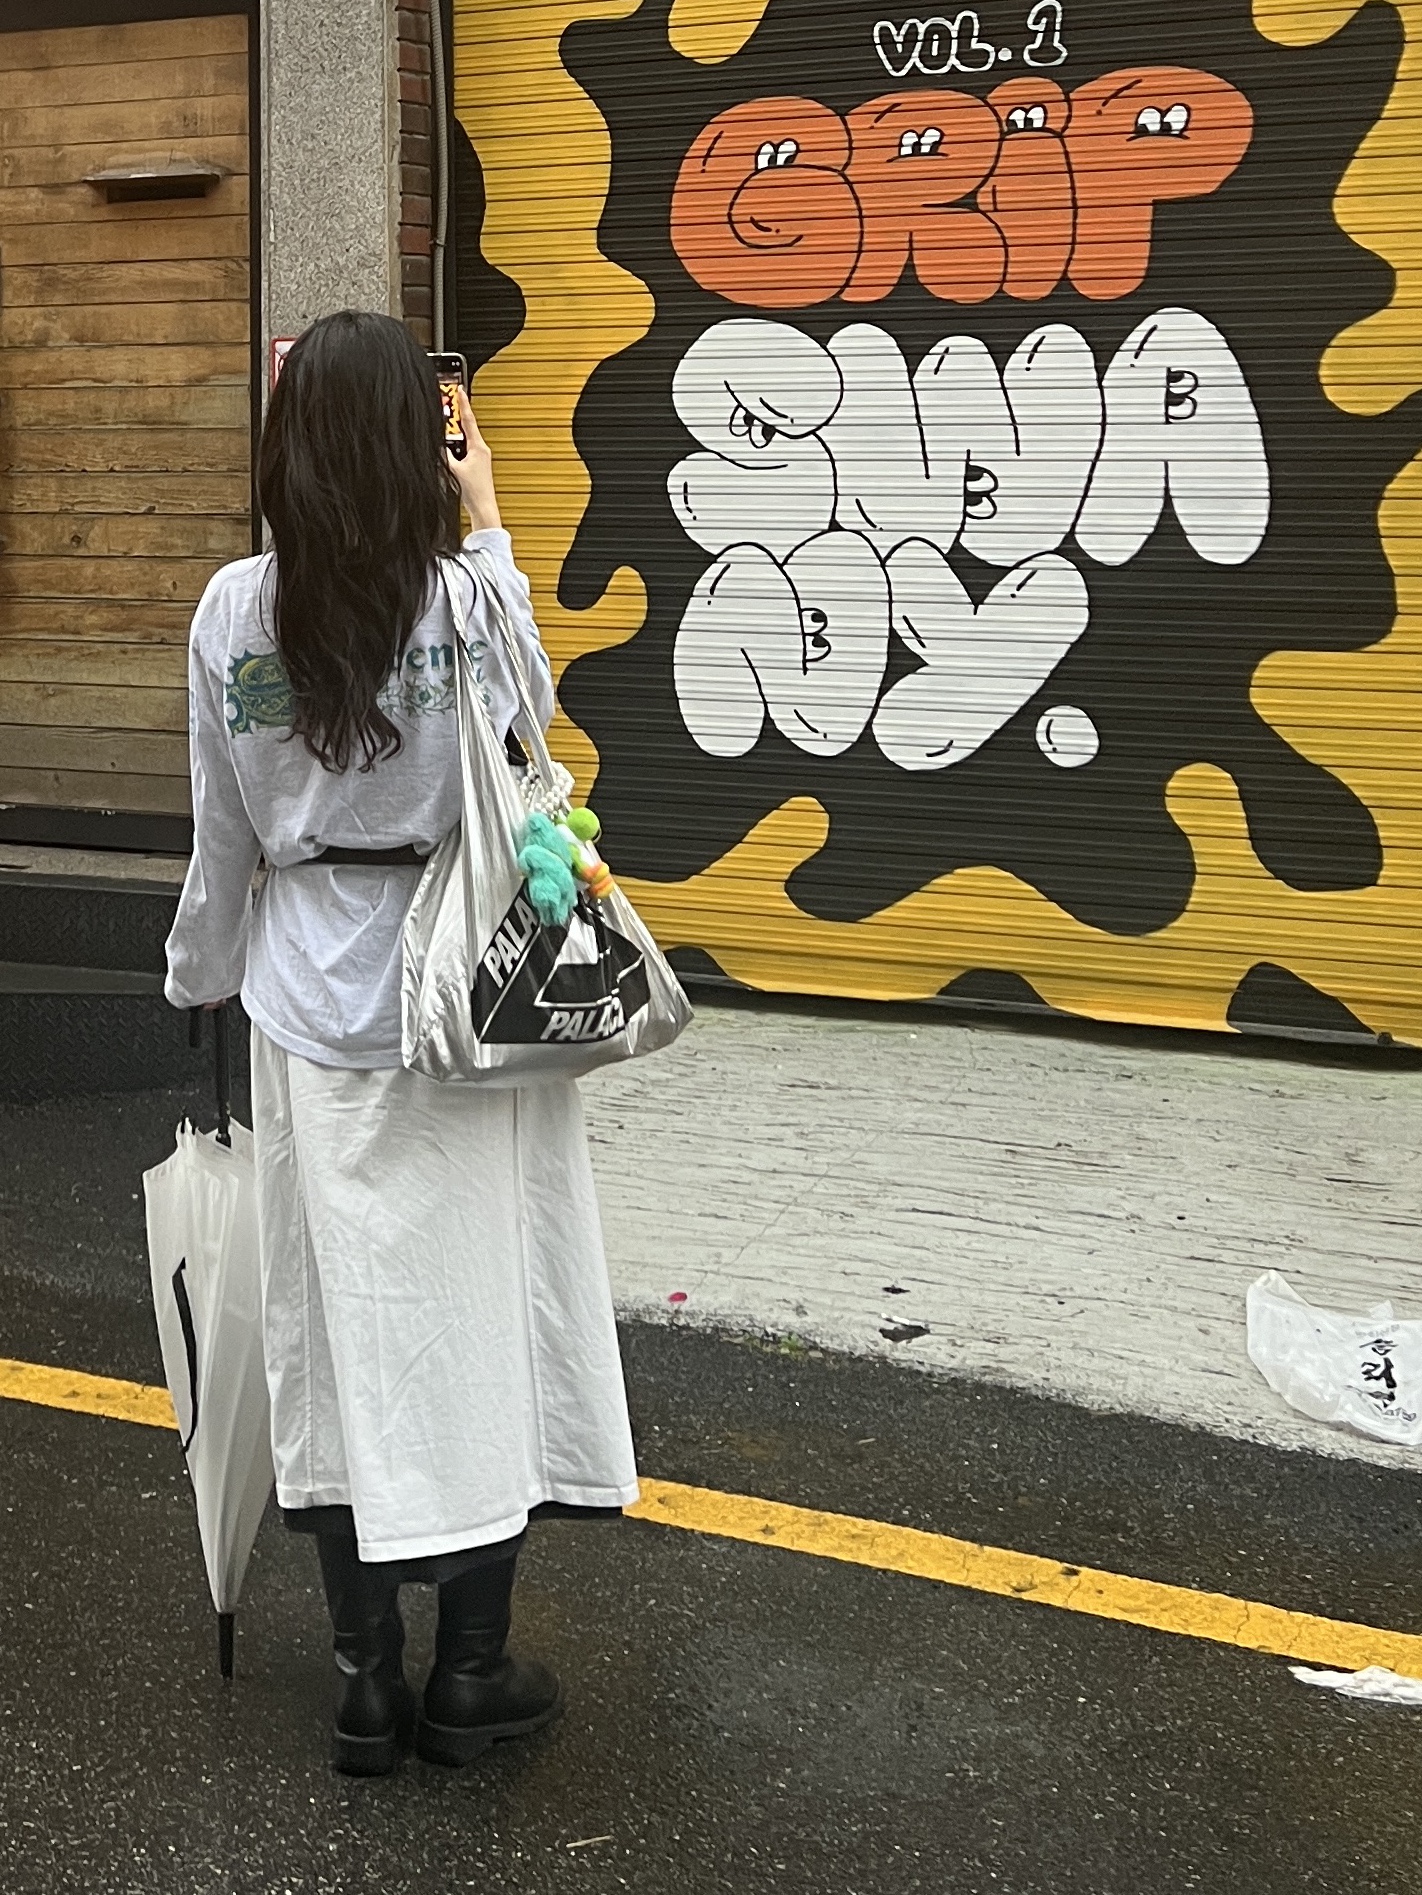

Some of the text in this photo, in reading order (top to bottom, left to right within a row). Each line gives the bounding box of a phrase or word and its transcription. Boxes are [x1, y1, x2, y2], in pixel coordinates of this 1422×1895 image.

[873, 0, 1068, 77] VOL. 1
[483, 896, 539, 989] PALA
